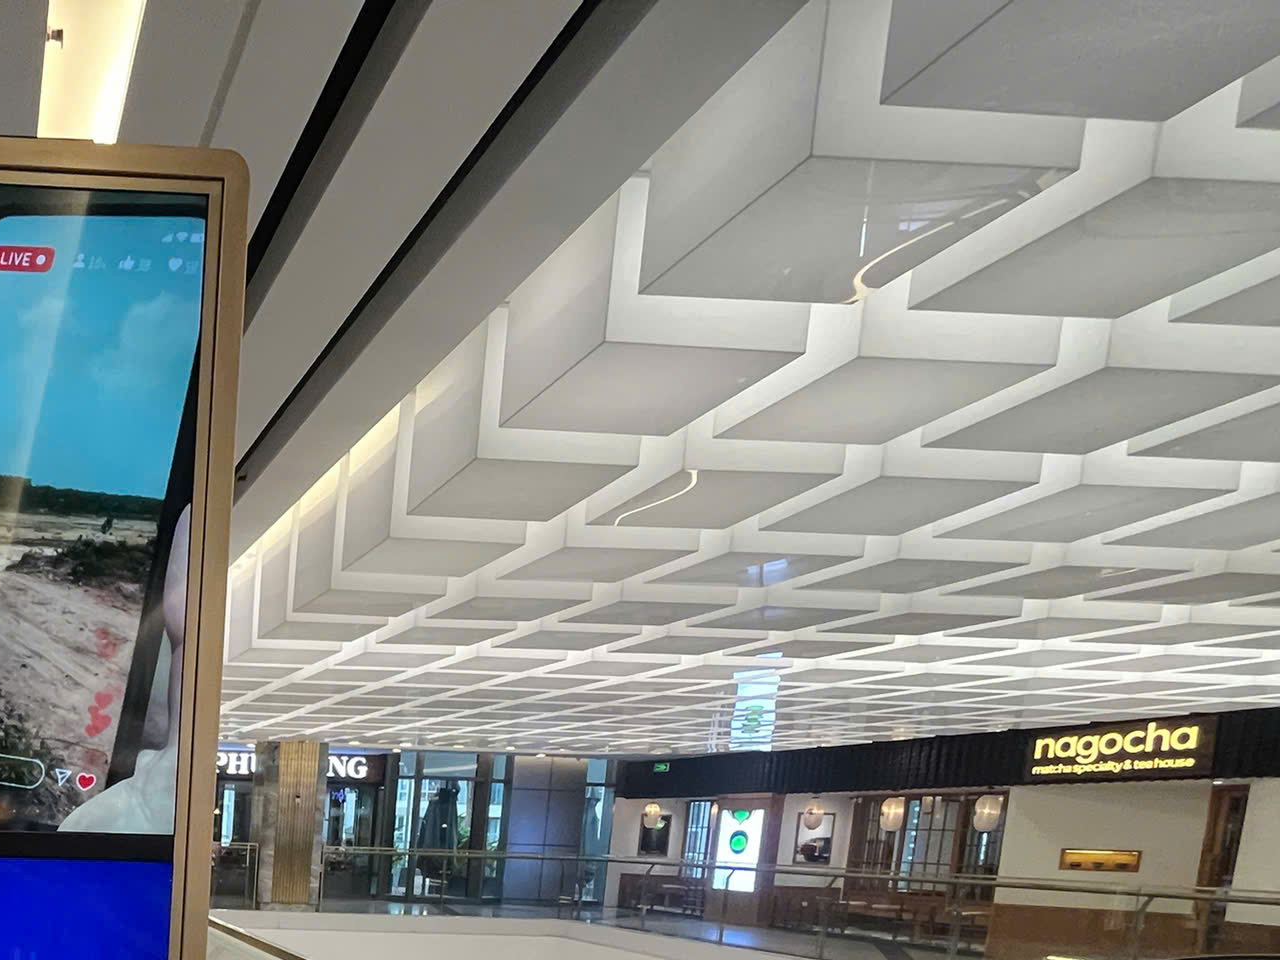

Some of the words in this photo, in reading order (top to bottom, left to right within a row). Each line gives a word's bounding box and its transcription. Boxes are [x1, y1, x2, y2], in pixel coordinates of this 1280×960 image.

[0, 251, 33, 267] LIVE
[1033, 721, 1200, 764] nagocha
[1154, 757, 1195, 769] house
